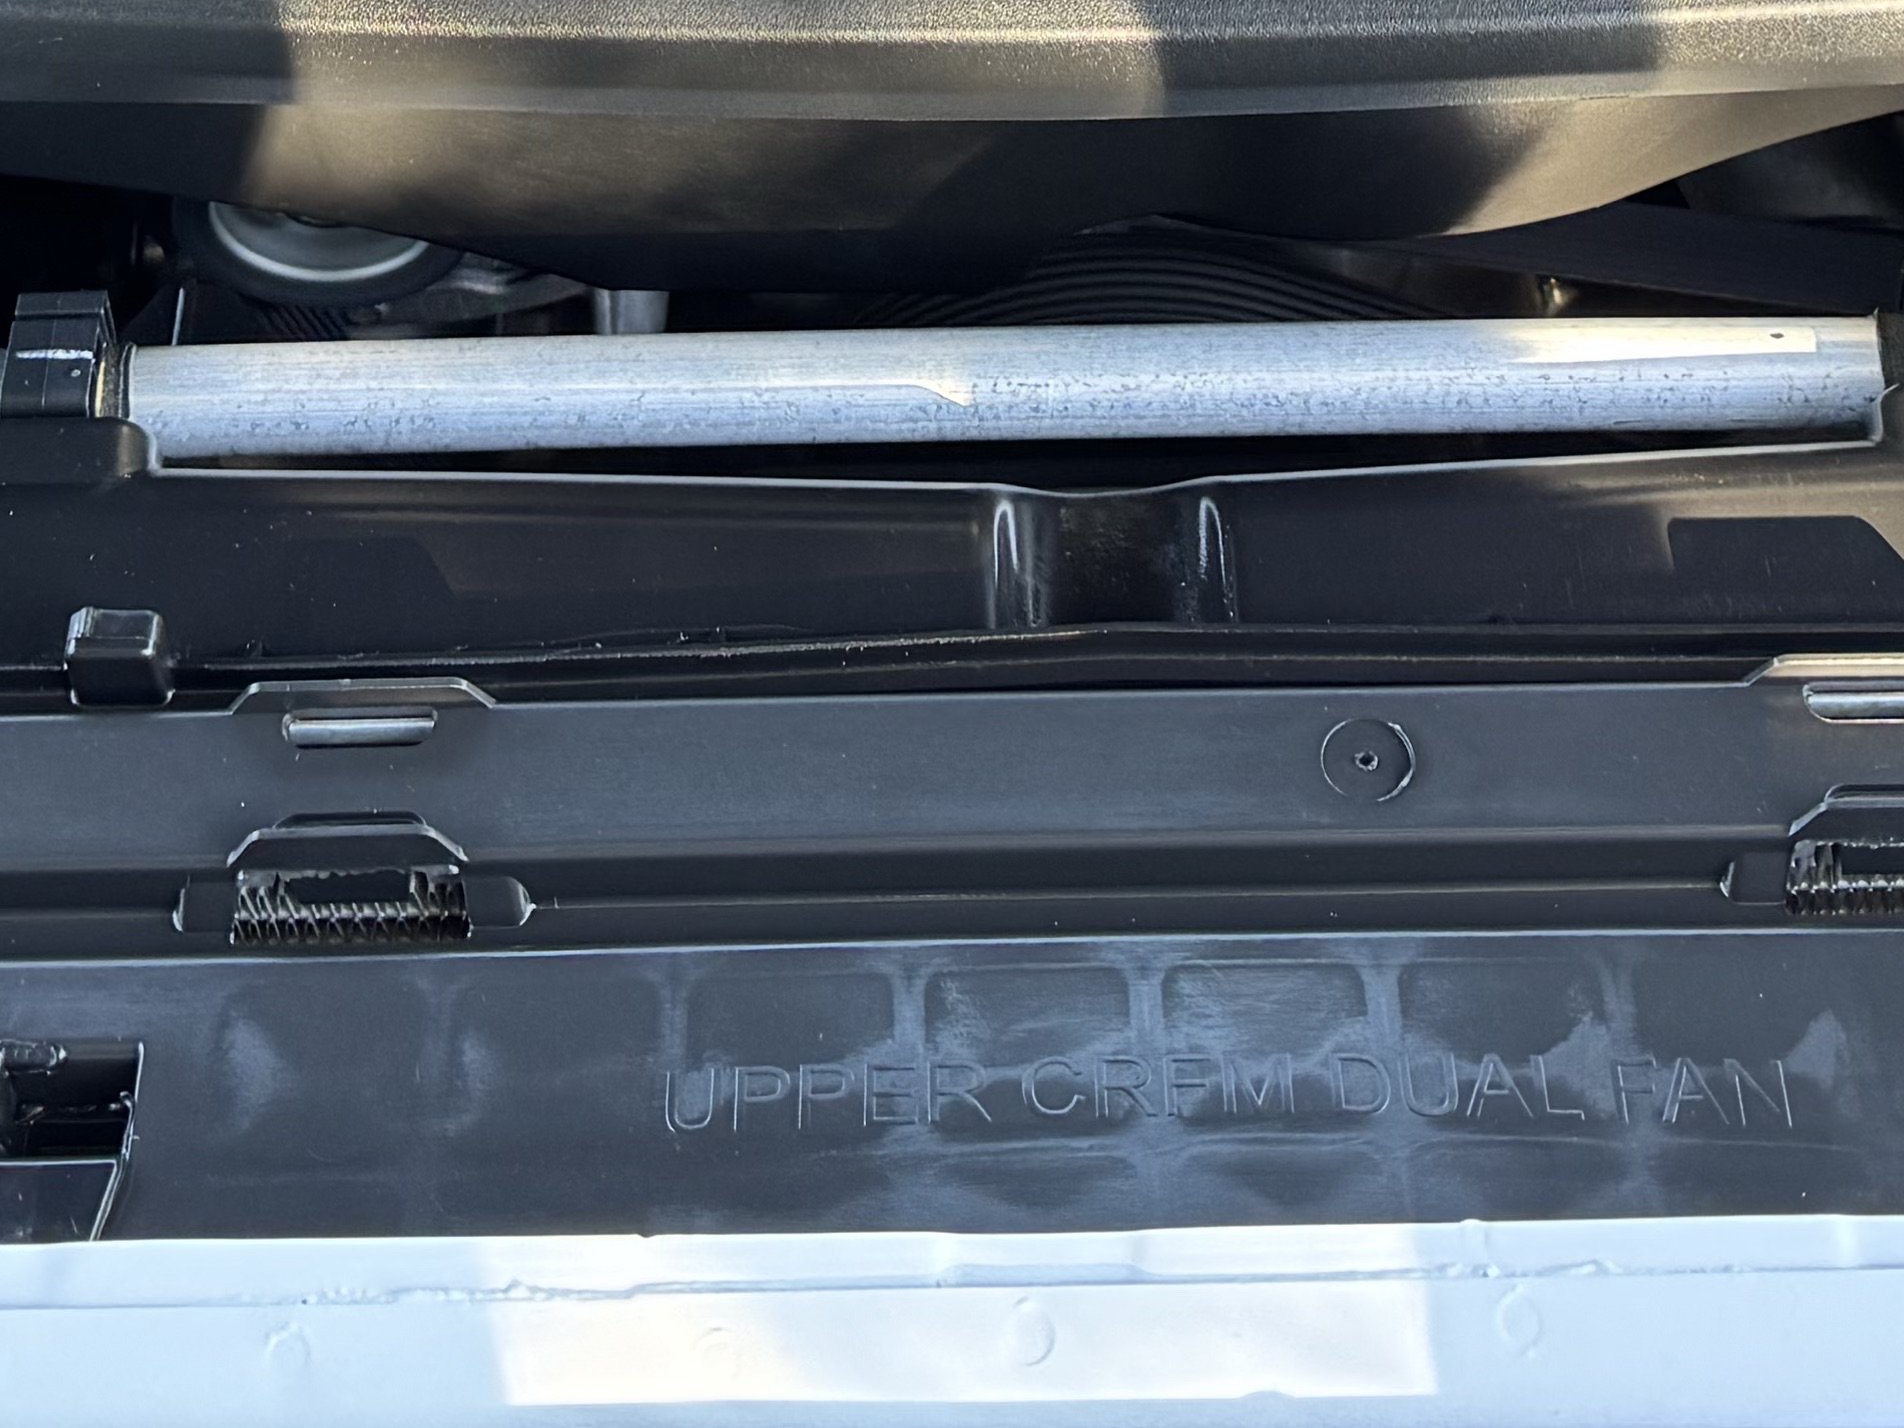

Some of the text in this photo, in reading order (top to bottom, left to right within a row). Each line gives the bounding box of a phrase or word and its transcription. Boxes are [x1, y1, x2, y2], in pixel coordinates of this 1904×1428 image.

[662, 1060, 991, 1134] UPPER
[1329, 1051, 1586, 1122] DUAL
[1611, 1055, 1795, 1129] FAN
